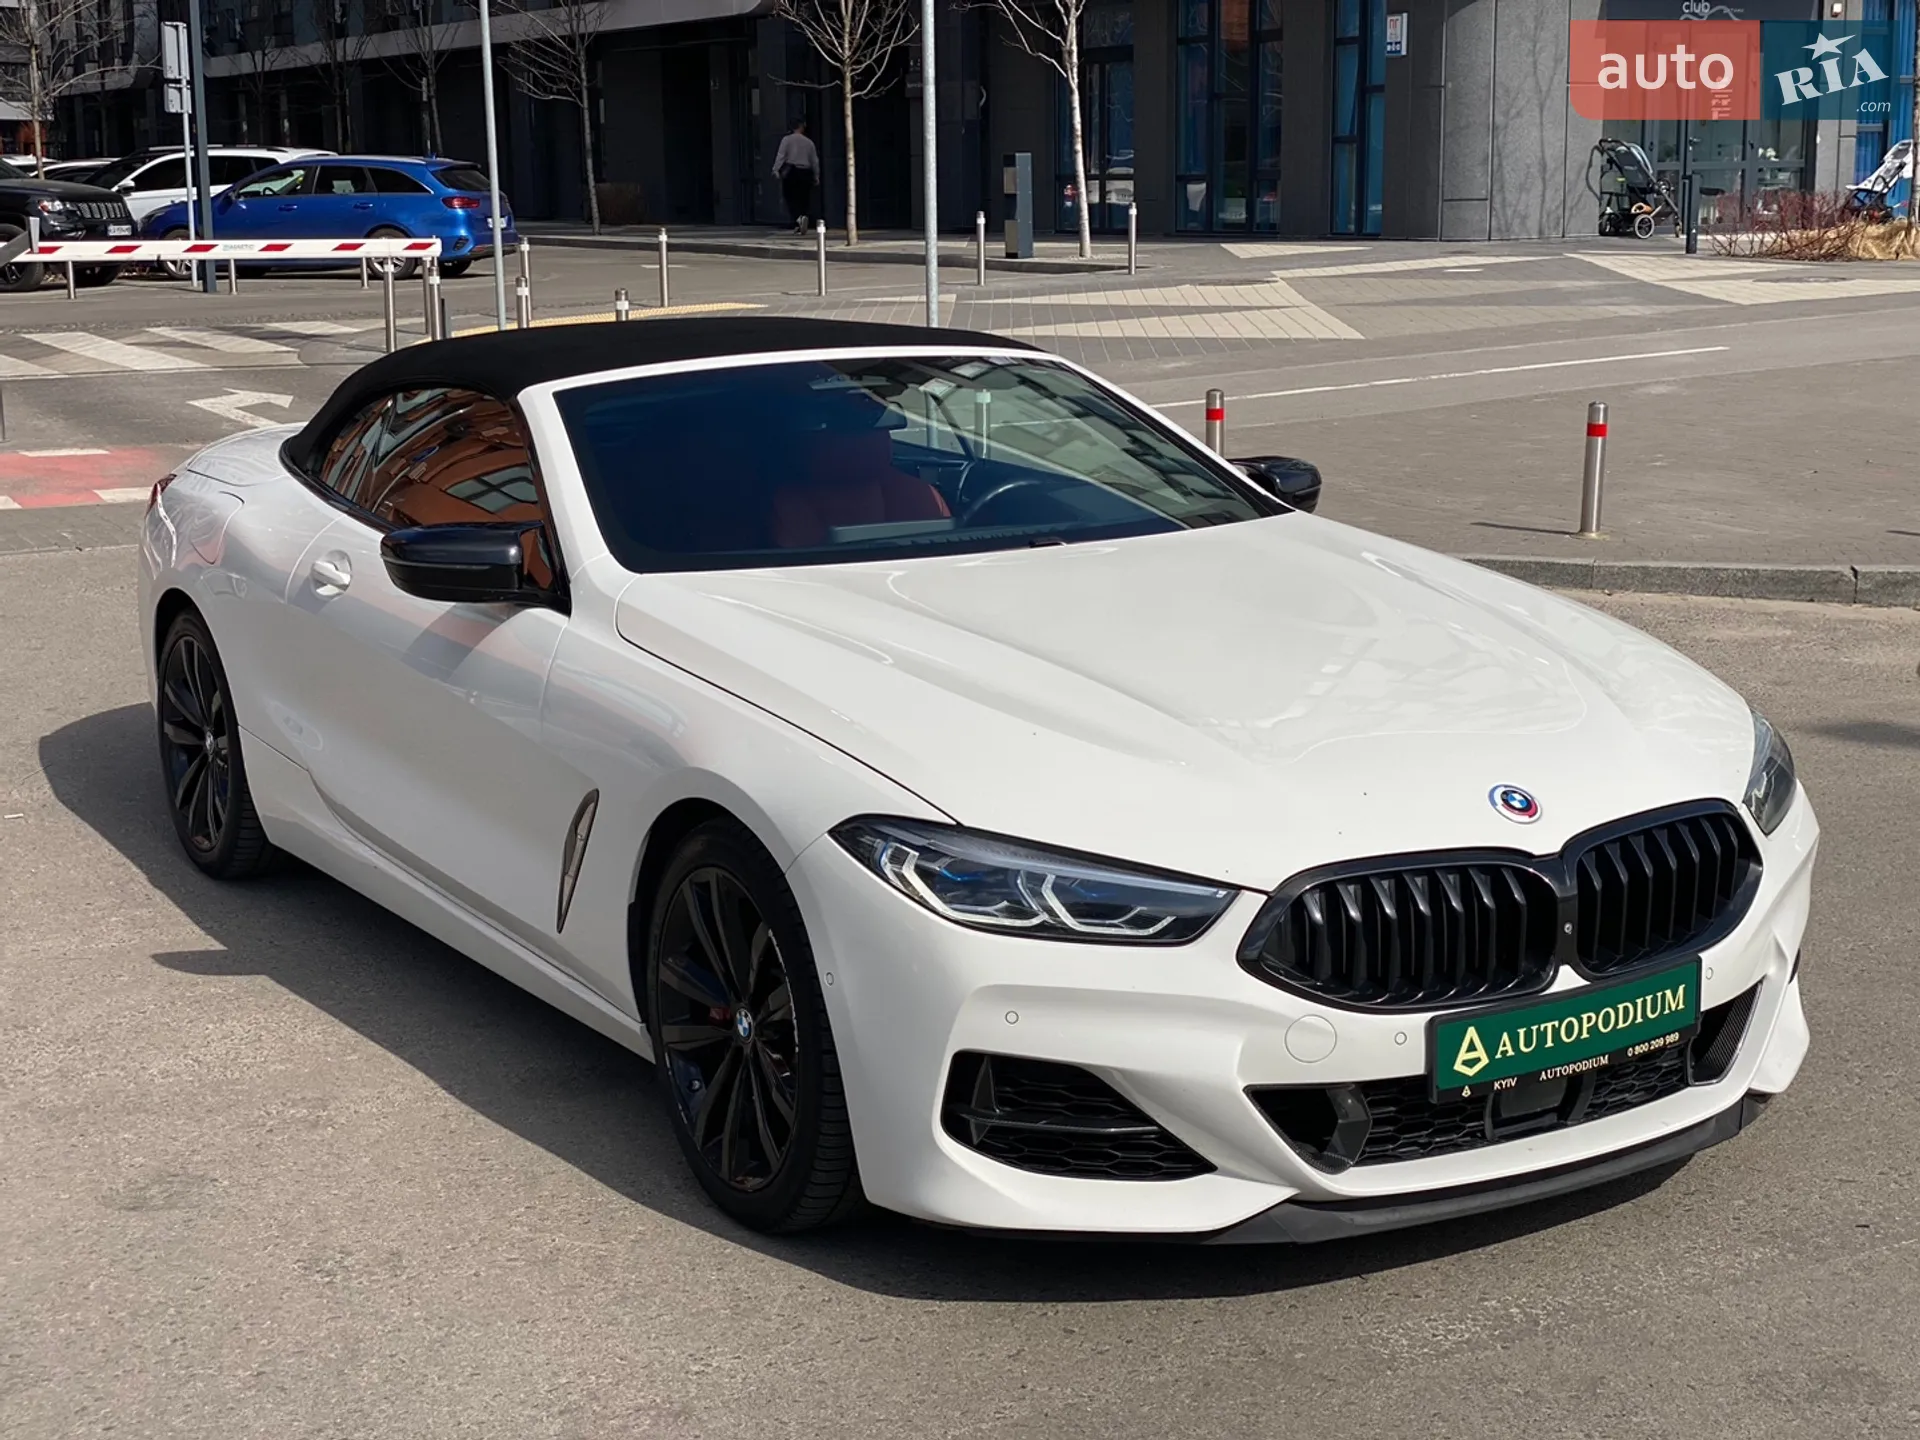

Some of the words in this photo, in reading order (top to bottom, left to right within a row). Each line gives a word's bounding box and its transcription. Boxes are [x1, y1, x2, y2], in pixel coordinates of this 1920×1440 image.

[1682, 0, 1710, 13] club
[1495, 984, 1686, 1059] AUTOPODIUM
[1493, 1076, 1518, 1091] KYIV
[1539, 1054, 1609, 1081] AUTOPODIUM
[1627, 1047, 1634, 1058] 0
[1634, 1042, 1649, 1055] 800
[1650, 1038, 1664, 1051] 209
